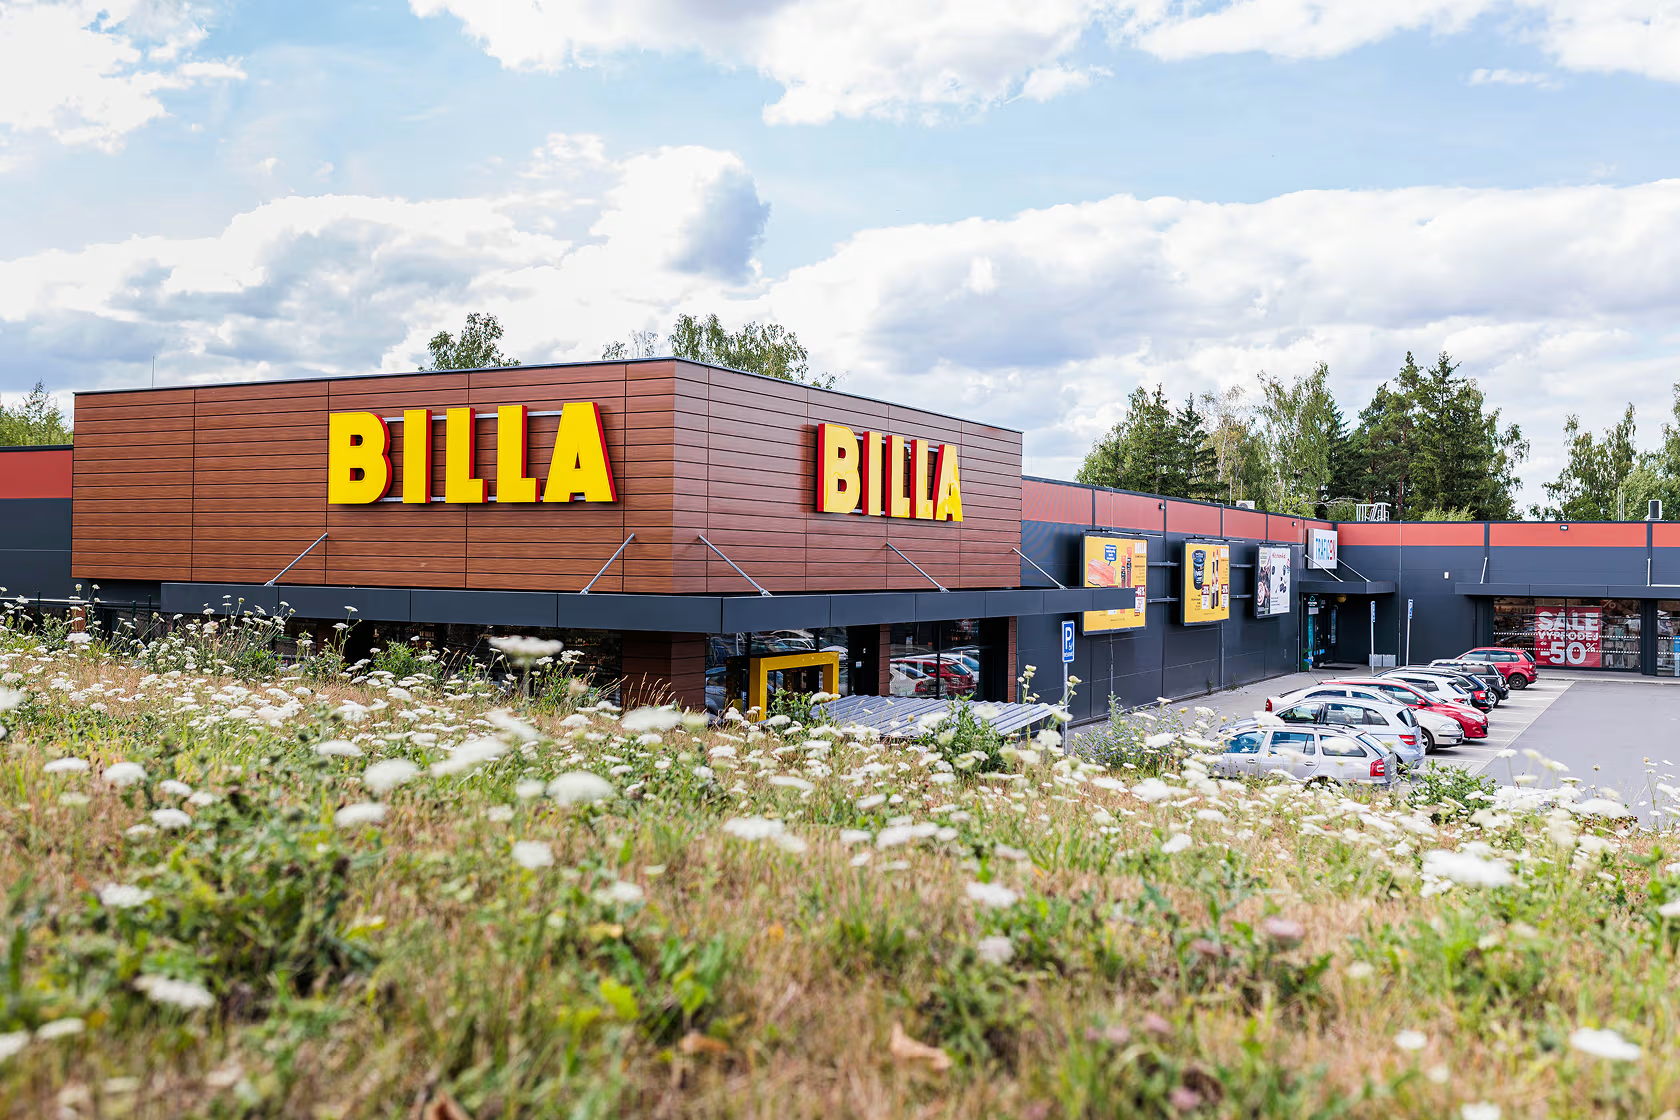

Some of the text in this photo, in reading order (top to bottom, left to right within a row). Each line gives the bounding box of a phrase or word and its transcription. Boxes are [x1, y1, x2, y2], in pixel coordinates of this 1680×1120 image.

[328, 401, 618, 505] BILLA
[817, 423, 964, 522] BILLA
[1537, 611, 1599, 631] SALE
[1065, 626, 1073, 650] P
[1537, 630, 1599, 641] VYPRODEJ
